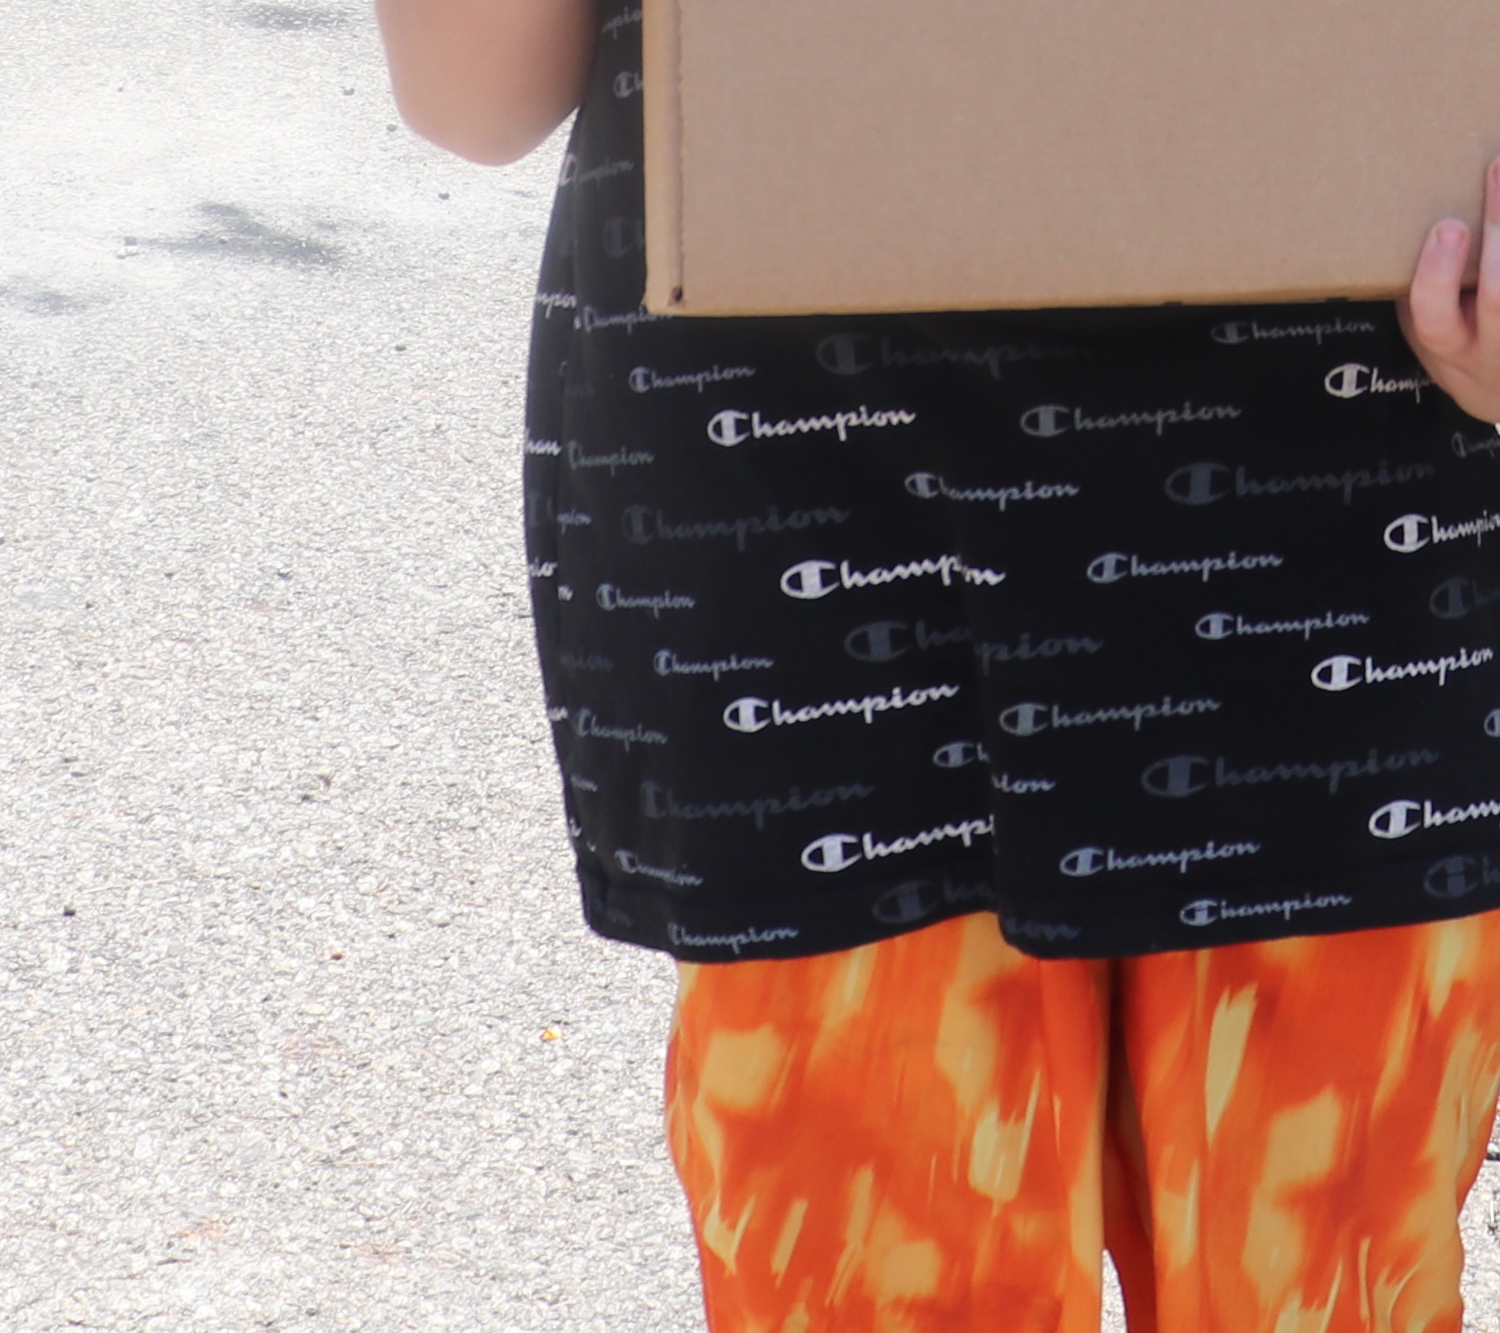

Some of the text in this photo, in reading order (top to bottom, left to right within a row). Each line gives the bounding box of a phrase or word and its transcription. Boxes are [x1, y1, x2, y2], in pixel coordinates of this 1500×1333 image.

[1210, 317, 1377, 345] Champion
[627, 364, 757, 394] Champion
[706, 404, 918, 448] Champion
[1019, 400, 1244, 439] Champion
[1163, 458, 1437, 507] Champion
[1086, 550, 1285, 584] Champion
[596, 583, 697, 619] Champion
[1195, 611, 1371, 641] Champion
[654, 648, 775, 682] Champion
[1310, 647, 1494, 692] Champion
[722, 682, 960, 733] Champion
[998, 695, 1222, 737] Champion
[1140, 746, 1441, 799] Champion
[1058, 839, 1261, 877] Champion
[1179, 893, 1353, 927] Champion
[666, 922, 800, 954] Champion
